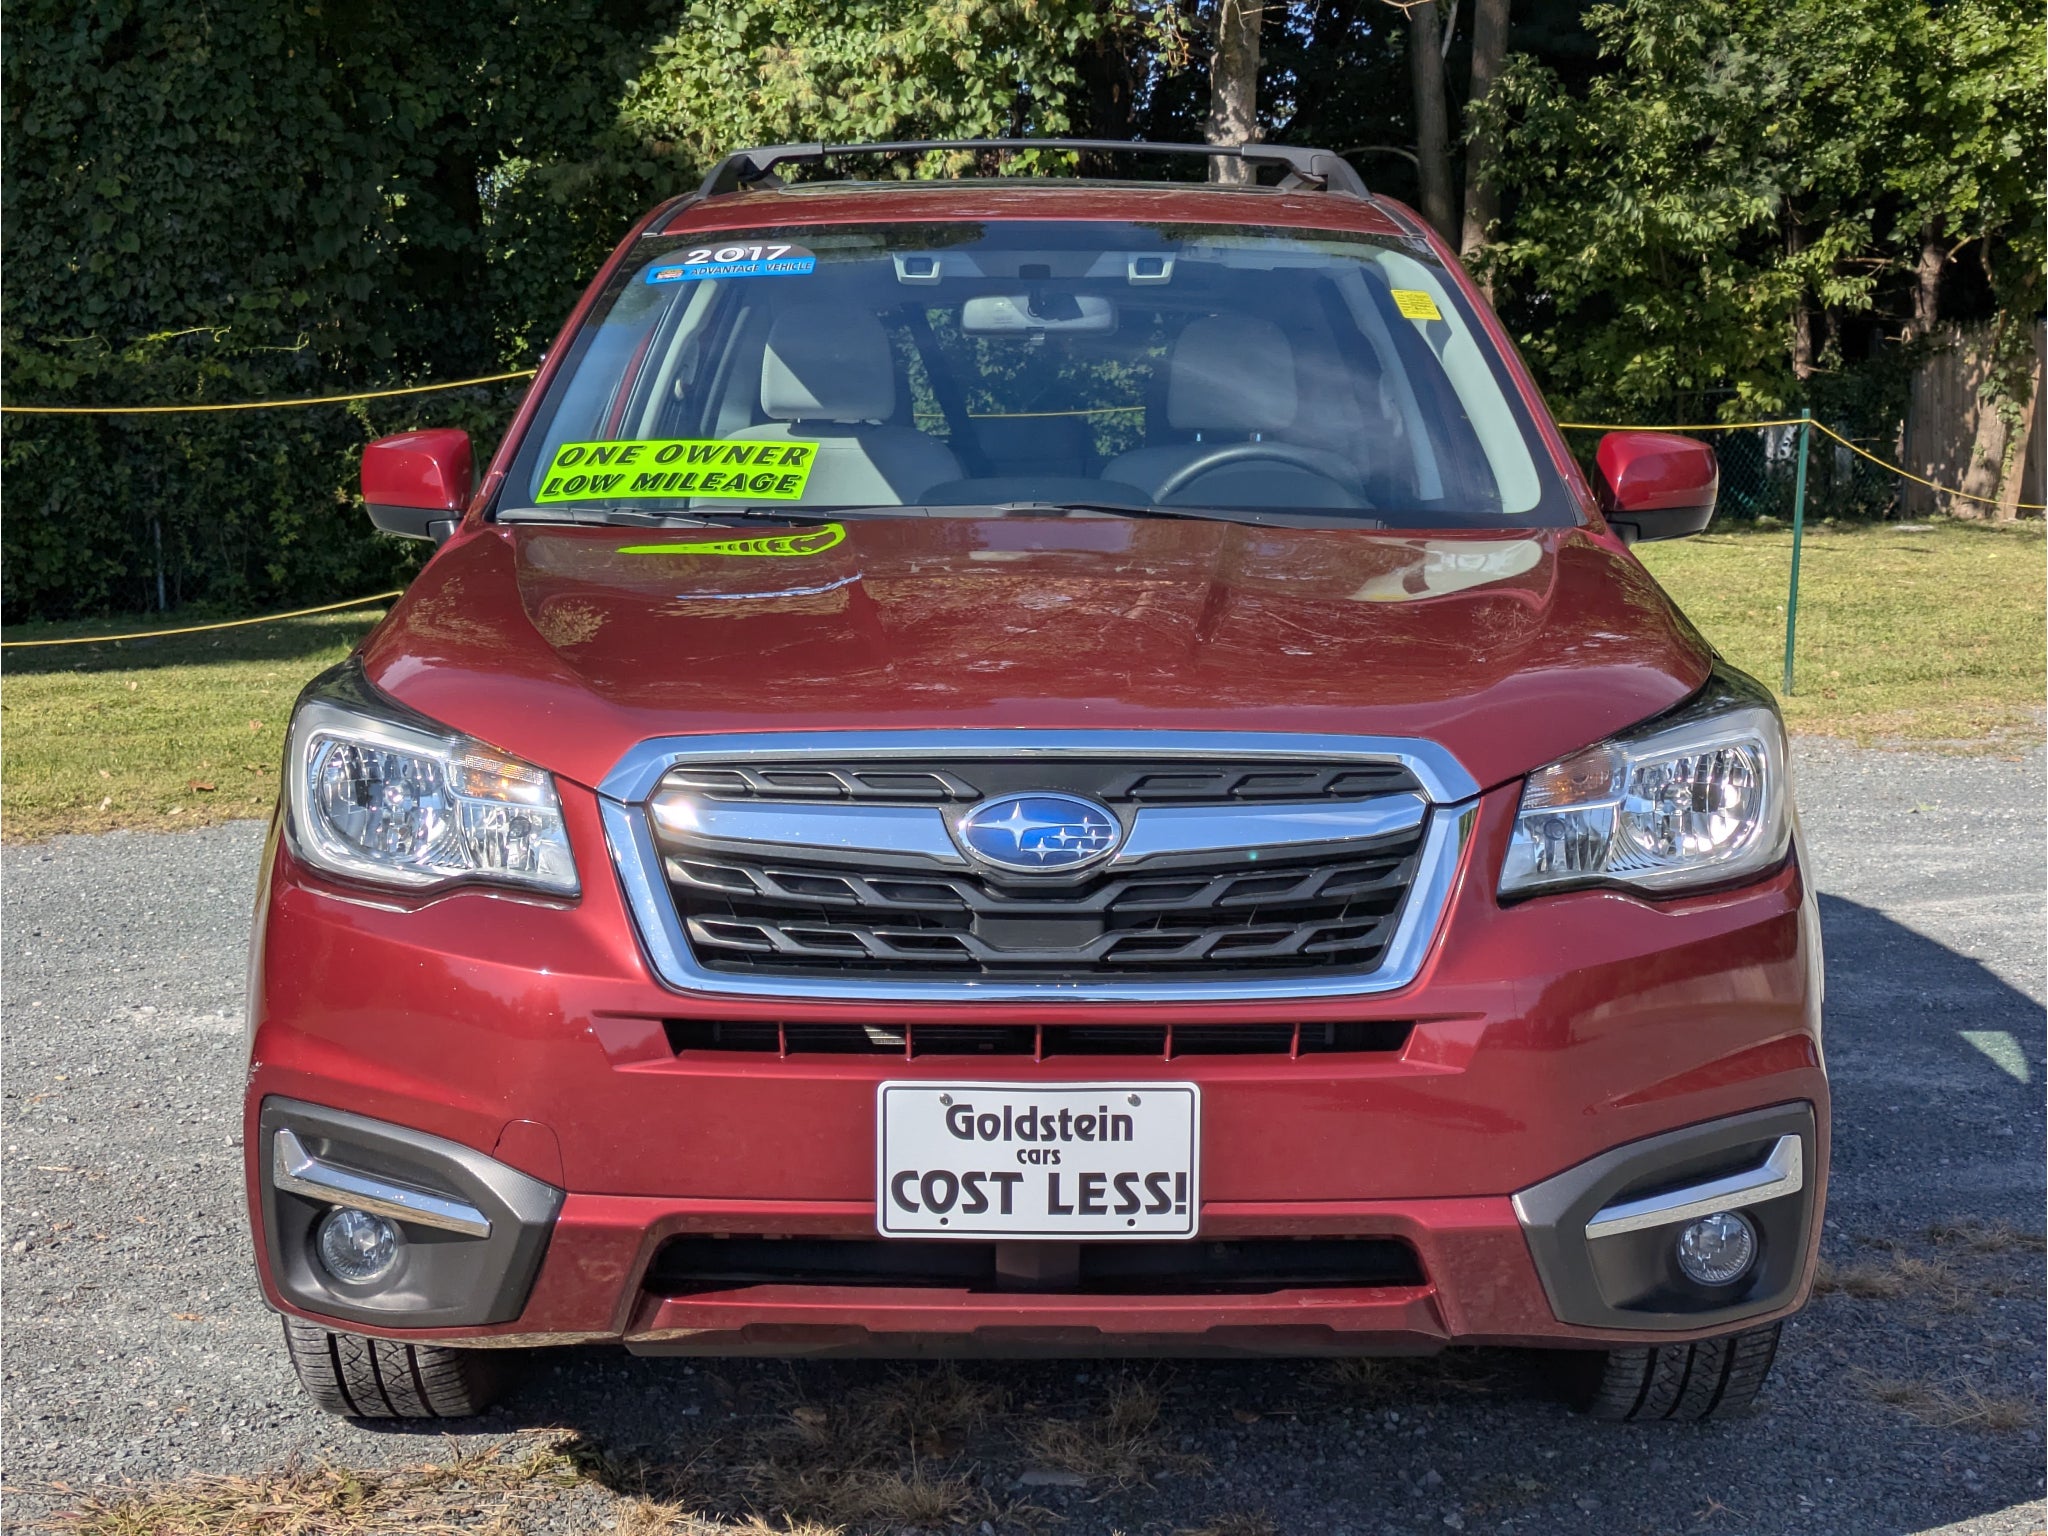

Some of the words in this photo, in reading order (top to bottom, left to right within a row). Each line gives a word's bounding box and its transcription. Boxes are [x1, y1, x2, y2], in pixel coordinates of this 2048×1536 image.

[685, 246, 792, 265] 2017
[691, 264, 759, 276] ADVANTAGE
[766, 262, 812, 271] VEHICLE
[557, 446, 646, 467] ONE
[655, 444, 810, 468] OWNER
[543, 473, 625, 496] LOW
[631, 472, 804, 493] MILEAGE
[945, 1104, 1134, 1141] Goldstein
[1016, 1148, 1061, 1165] cars
[890, 1169, 1024, 1215] COST
[1047, 1171, 1187, 1215] LESS!
